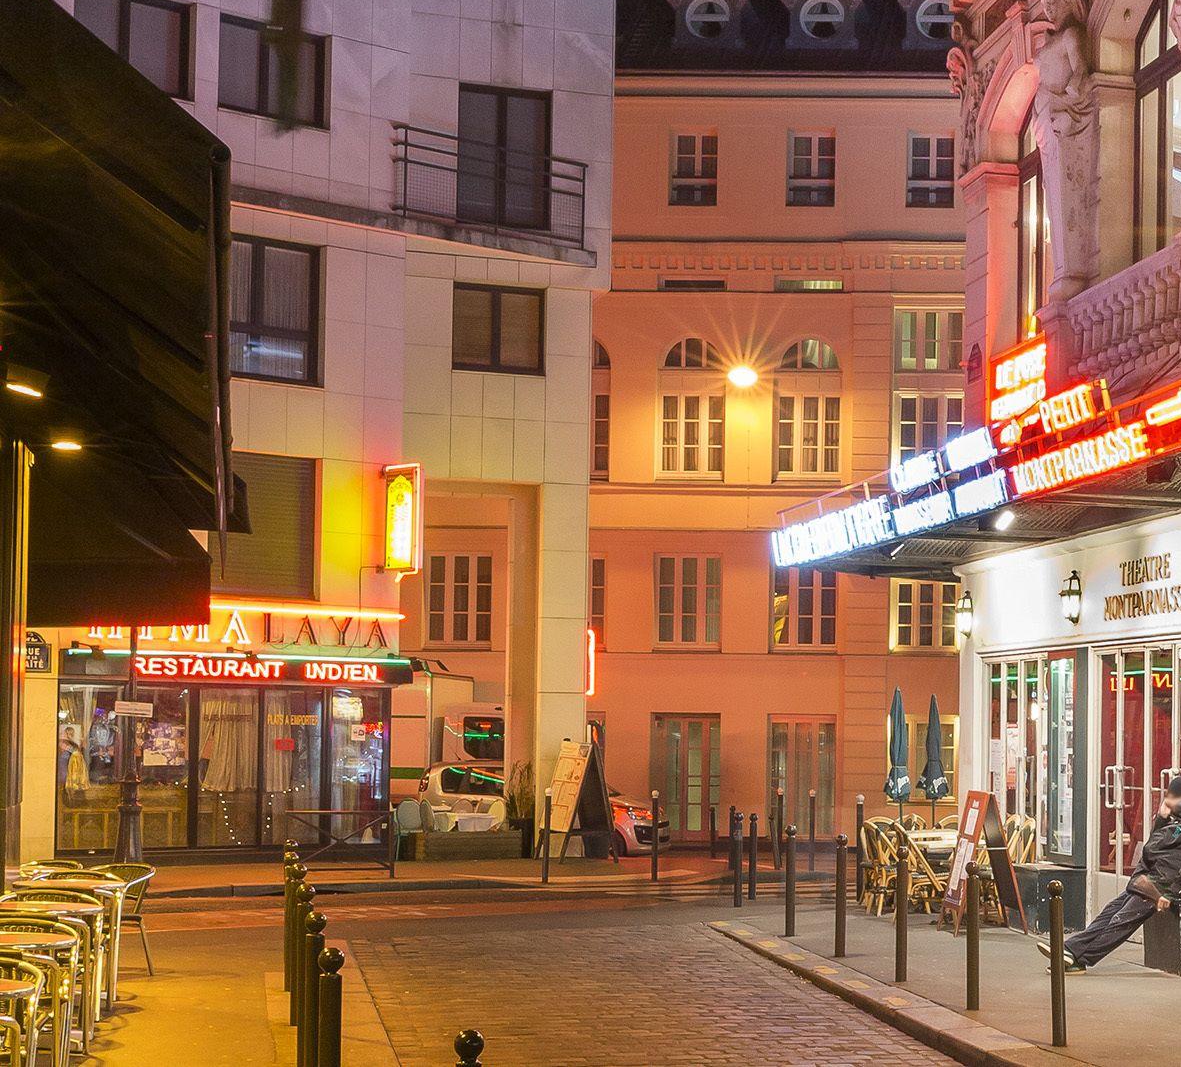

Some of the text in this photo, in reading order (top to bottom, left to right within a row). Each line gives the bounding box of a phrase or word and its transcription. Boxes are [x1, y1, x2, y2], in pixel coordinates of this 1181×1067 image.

[1040, 385, 1092, 433] PETIT
[1010, 422, 1149, 495] MONTPARNASSE
[26, 647, 40, 656] UE
[135, 656, 378, 681] RESTAURANT INDIEN
[290, 714, 319, 726] EMPORTER
